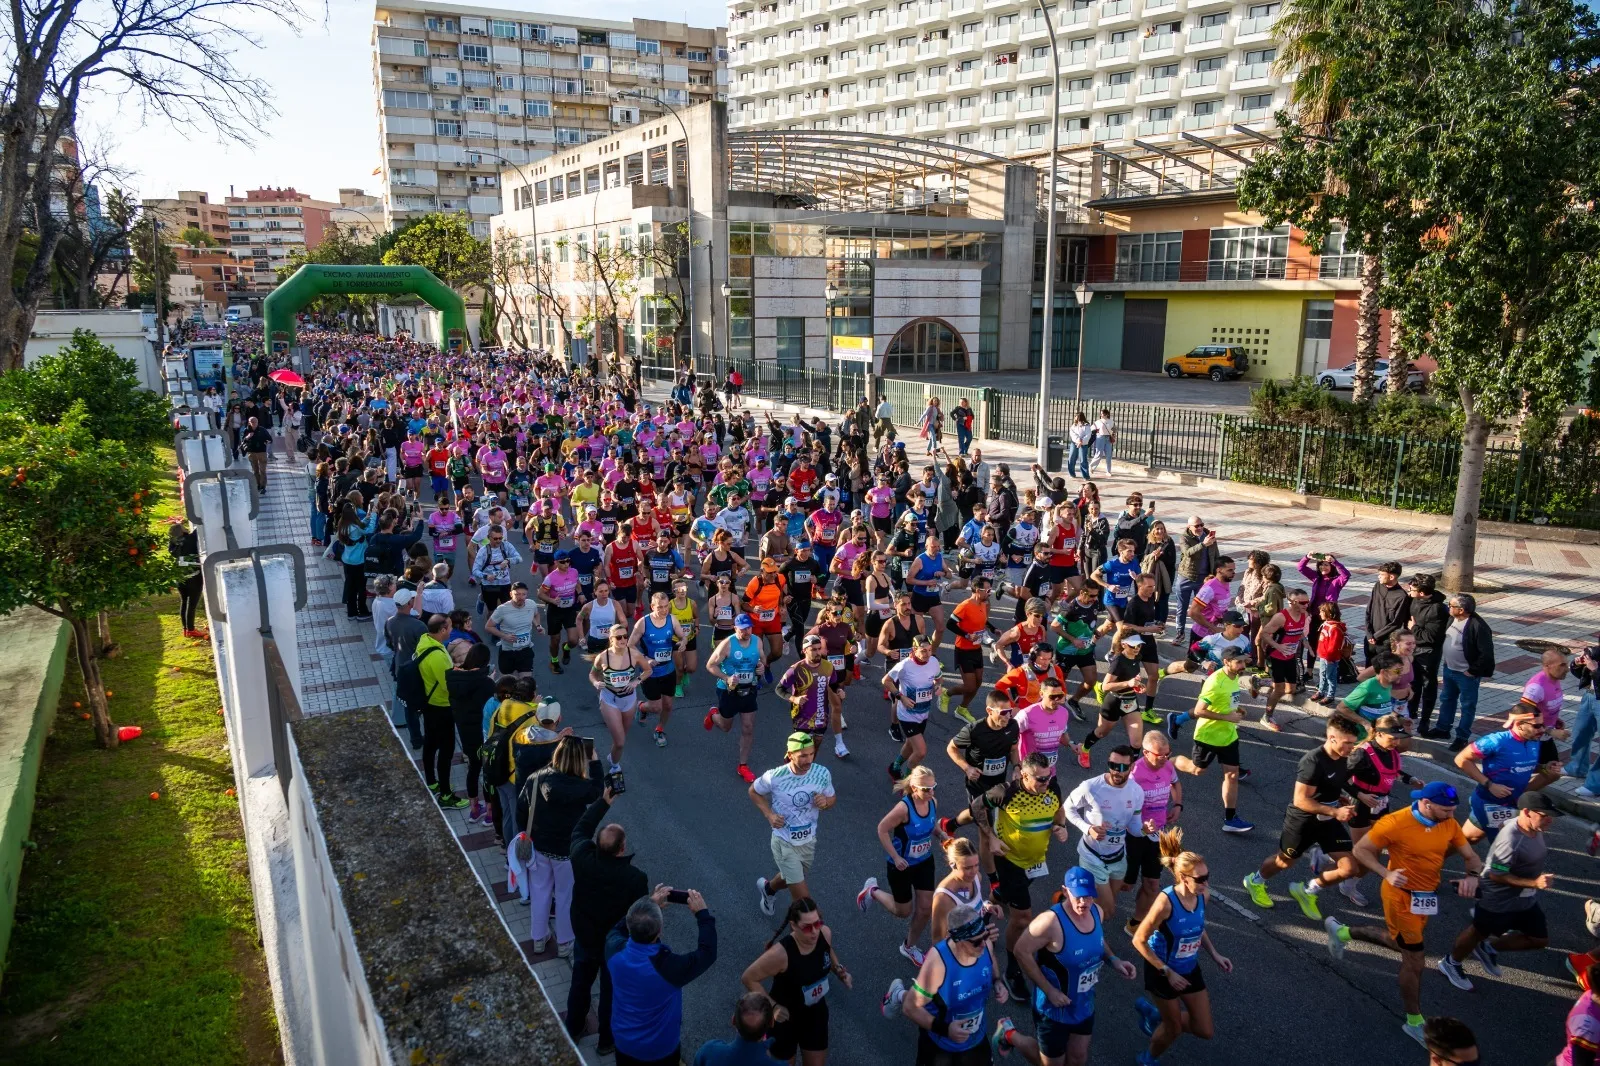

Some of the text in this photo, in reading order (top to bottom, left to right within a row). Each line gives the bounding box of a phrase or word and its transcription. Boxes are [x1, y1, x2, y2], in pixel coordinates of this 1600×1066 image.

[985, 763, 1005, 771] 1803
[1492, 811, 1512, 819] 655
[1108, 836, 1121, 844] 43
[1413, 898, 1436, 907] 2186
[811, 985, 823, 998] 46
